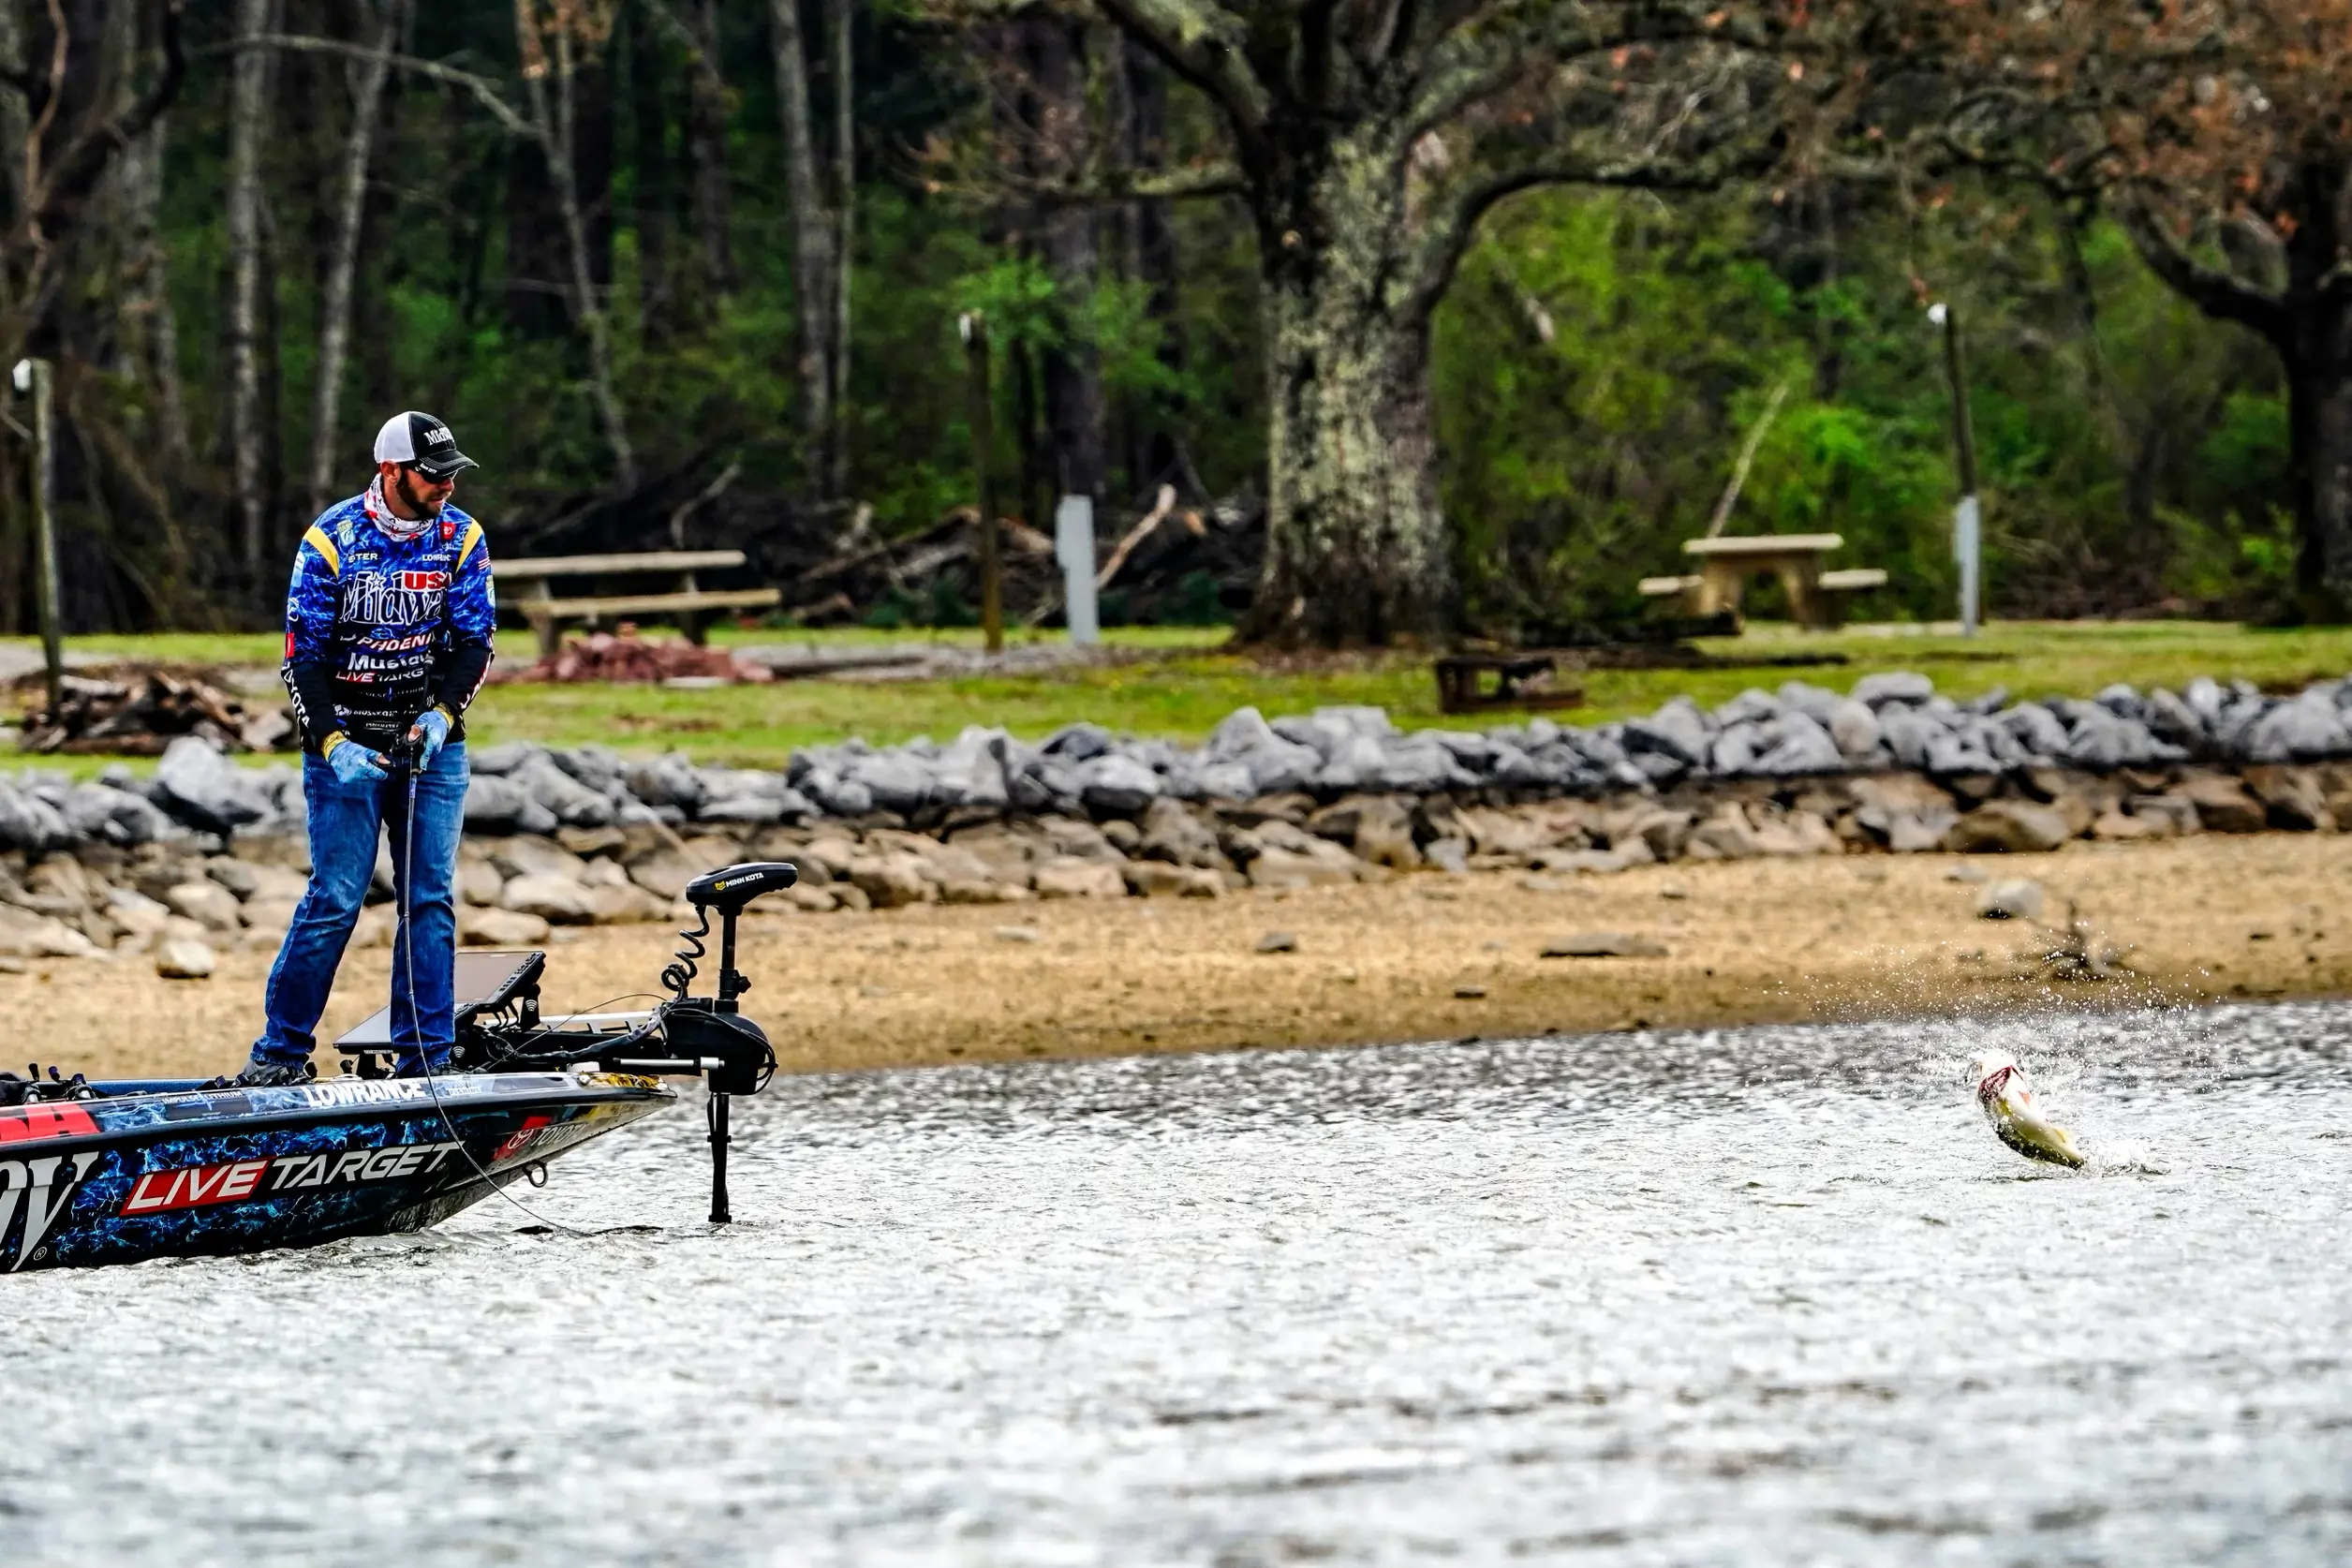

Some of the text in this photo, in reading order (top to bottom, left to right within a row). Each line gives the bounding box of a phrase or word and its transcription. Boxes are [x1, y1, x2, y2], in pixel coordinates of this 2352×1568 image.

[357, 632, 436, 651] PHOENI
[377, 668, 424, 683] TARG
[726, 872, 764, 887] MINN KOTA
[203, 1090, 243, 1100] LITHIUM
[301, 1079, 426, 1107] LOWRANCE
